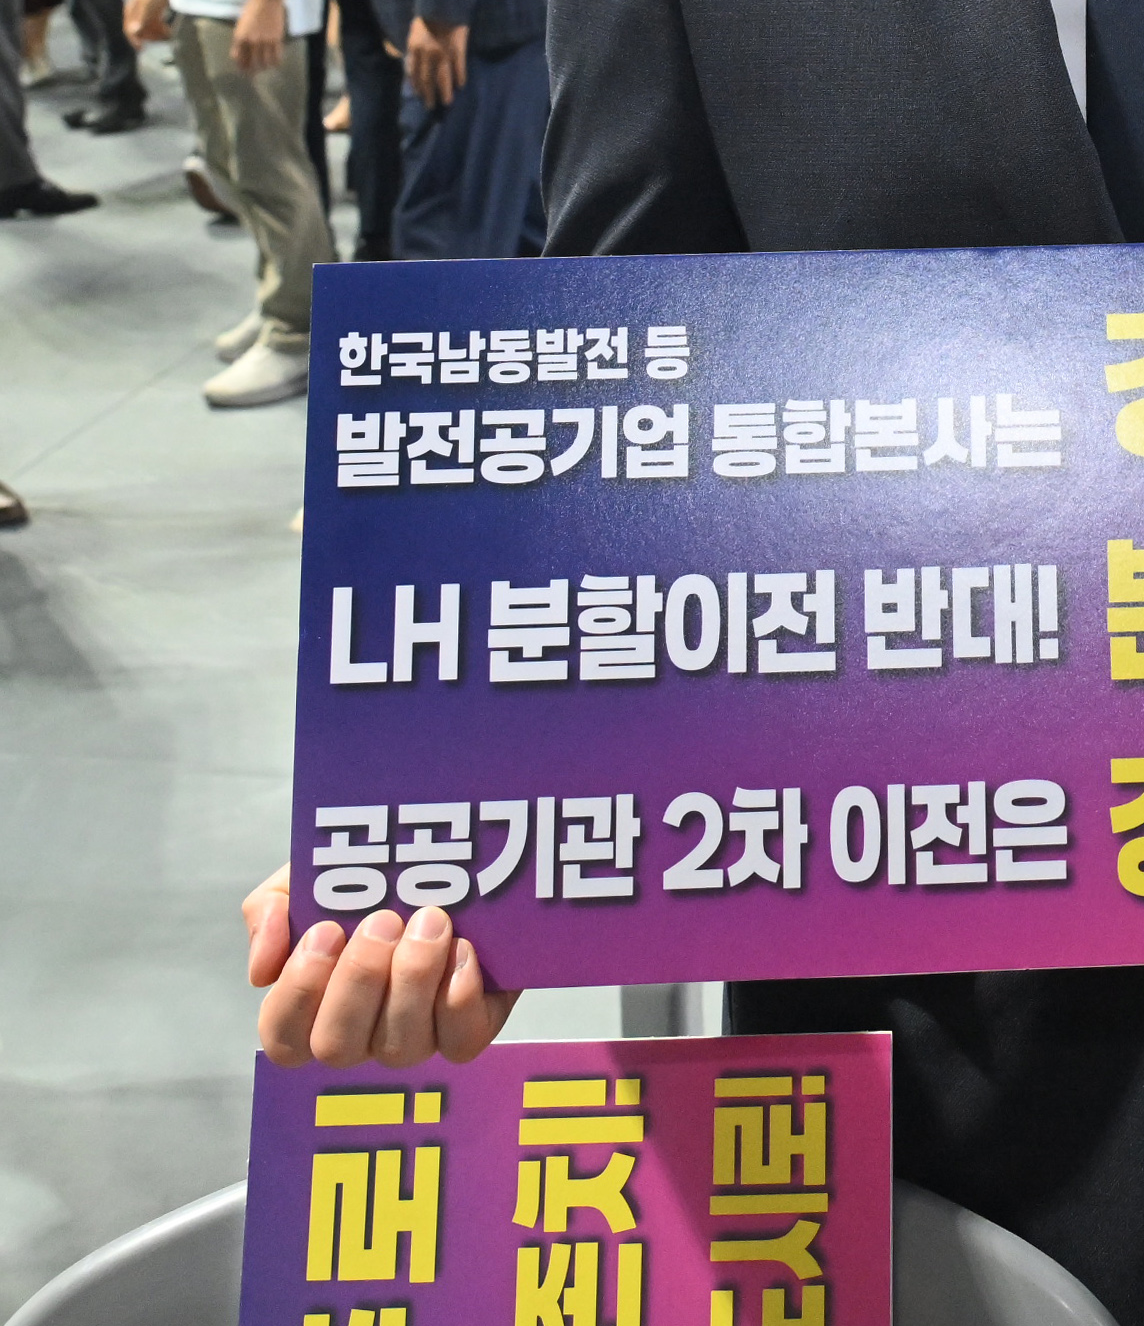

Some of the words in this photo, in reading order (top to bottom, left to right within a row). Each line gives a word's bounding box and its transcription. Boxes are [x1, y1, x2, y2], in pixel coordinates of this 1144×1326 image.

[338, 327, 629, 387] 한국남동발전
[645, 326, 691, 380] 등
[336, 405, 690, 488] 발전공기업
[712, 394, 1061, 478] 통합본사는
[330, 583, 460, 685] LH
[487, 569, 839, 683] 분할이전
[864, 563, 1059, 670] 반대!
[311, 792, 642, 911] 공공기관
[662, 786, 807, 891] 2차
[829, 778, 1067, 886] 이전은
[303, 1092, 441, 1326] 로!
